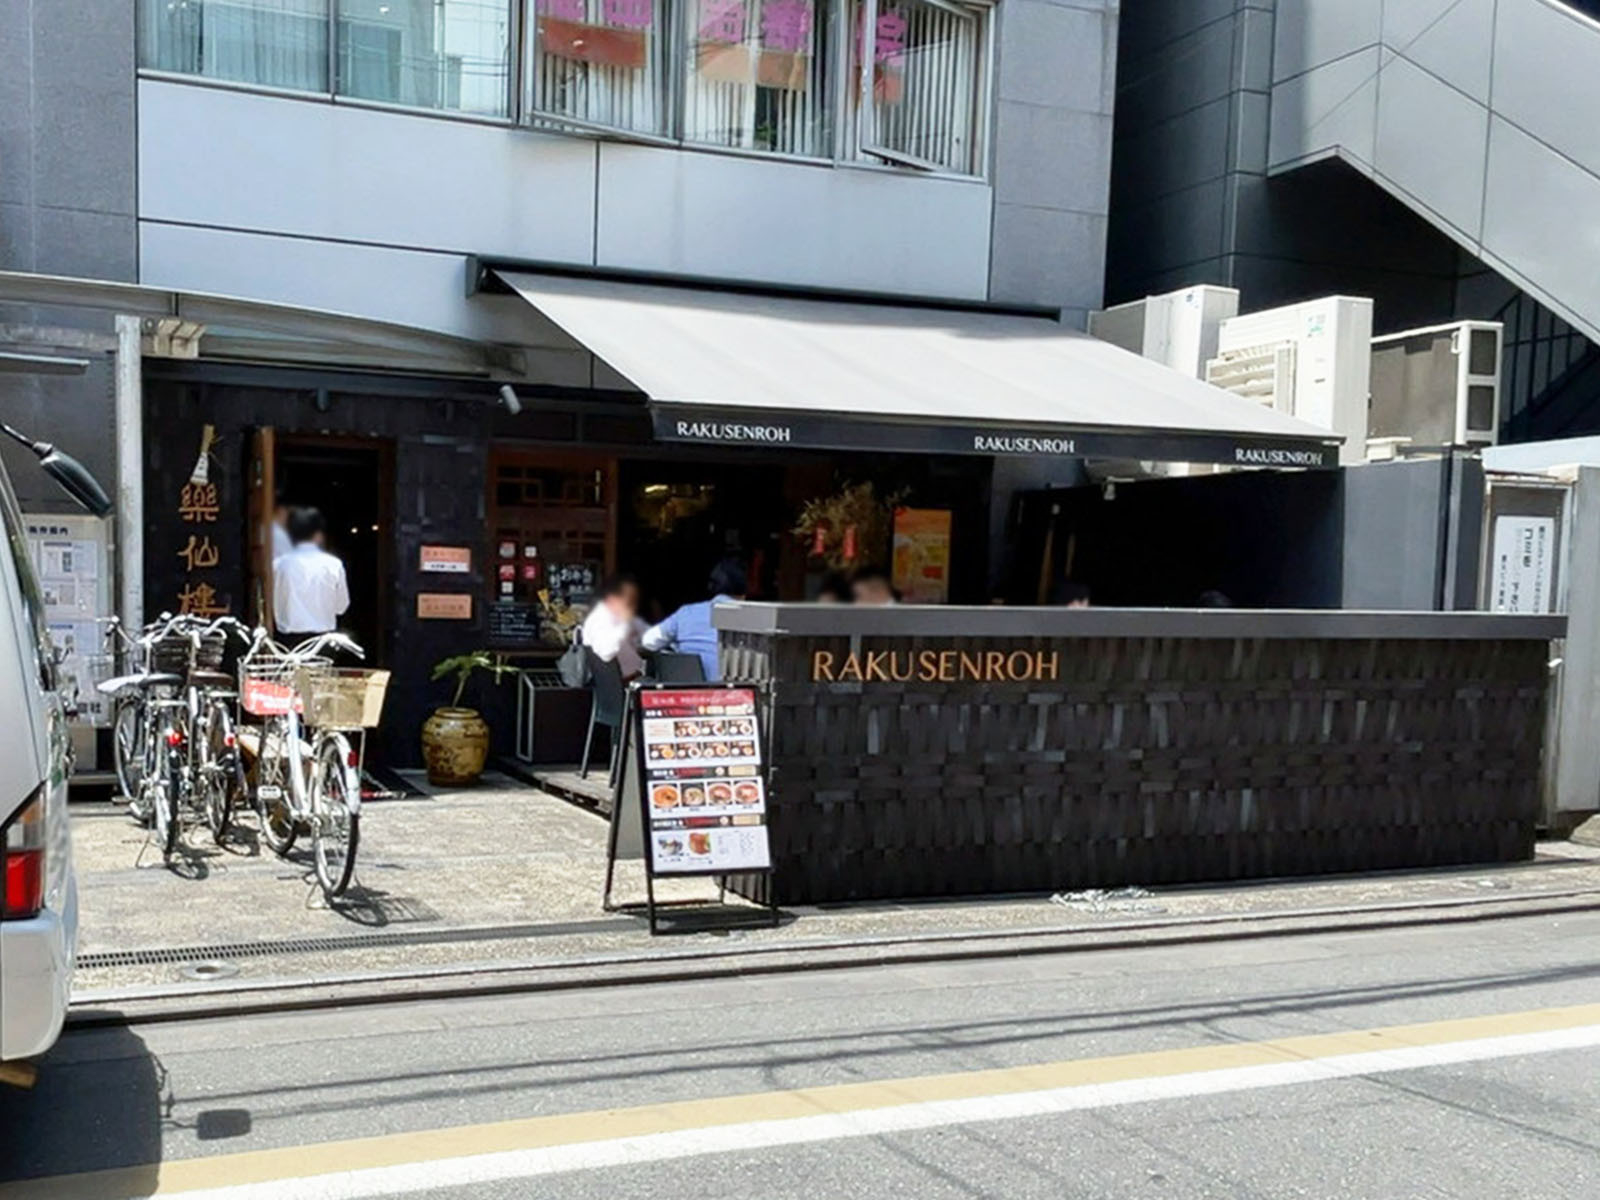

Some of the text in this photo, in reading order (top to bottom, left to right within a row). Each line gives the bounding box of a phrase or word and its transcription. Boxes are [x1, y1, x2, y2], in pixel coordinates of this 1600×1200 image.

[676, 421, 791, 441] RAKUSENROH
[974, 435, 1075, 453] RAKUSENROH
[1235, 448, 1323, 465] RAKUSENROH
[812, 650, 1059, 682] RAKUSENROH
